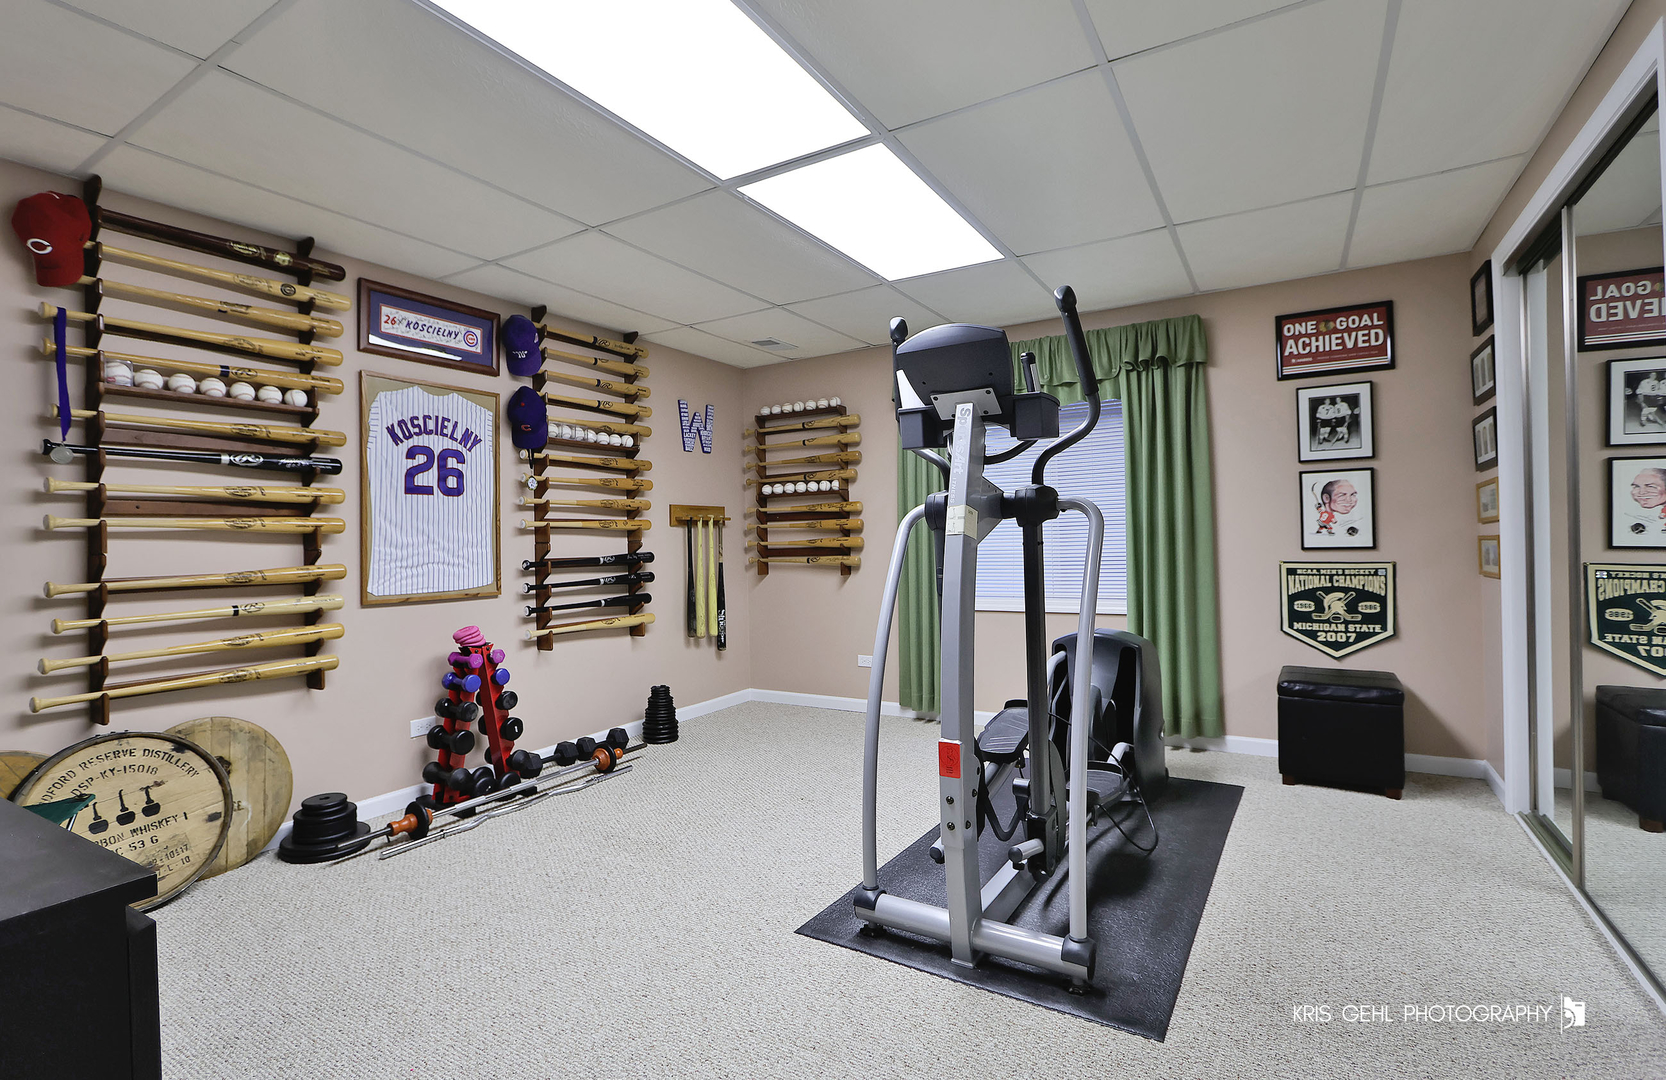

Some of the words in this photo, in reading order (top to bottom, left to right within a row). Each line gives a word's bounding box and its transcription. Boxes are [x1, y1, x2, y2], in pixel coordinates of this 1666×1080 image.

[383, 314, 397, 326] 26
[405, 320, 460, 340] KOSCIELNY
[1283, 321, 1318, 336] ONE
[1335, 312, 1384, 330] GOAL
[1284, 328, 1384, 356] ACHIEVED
[385, 414, 483, 453] KOSCIELNY
[404, 445, 466, 497] 26
[1288, 575, 1332, 595] NATIONAL
[1333, 575, 1386, 597] CHAMPIONS
[1293, 622, 1346, 632] MICHIGAN
[1347, 624, 1383, 633] STATE
[1316, 632, 1357, 643] 2007
[40, 769, 77, 803] DFORD
[78, 747, 137, 771] RESERVE
[142, 748, 200, 778] DISTILLERY
[129, 814, 178, 837] WHISKEY
[128, 839, 146, 851] 53
